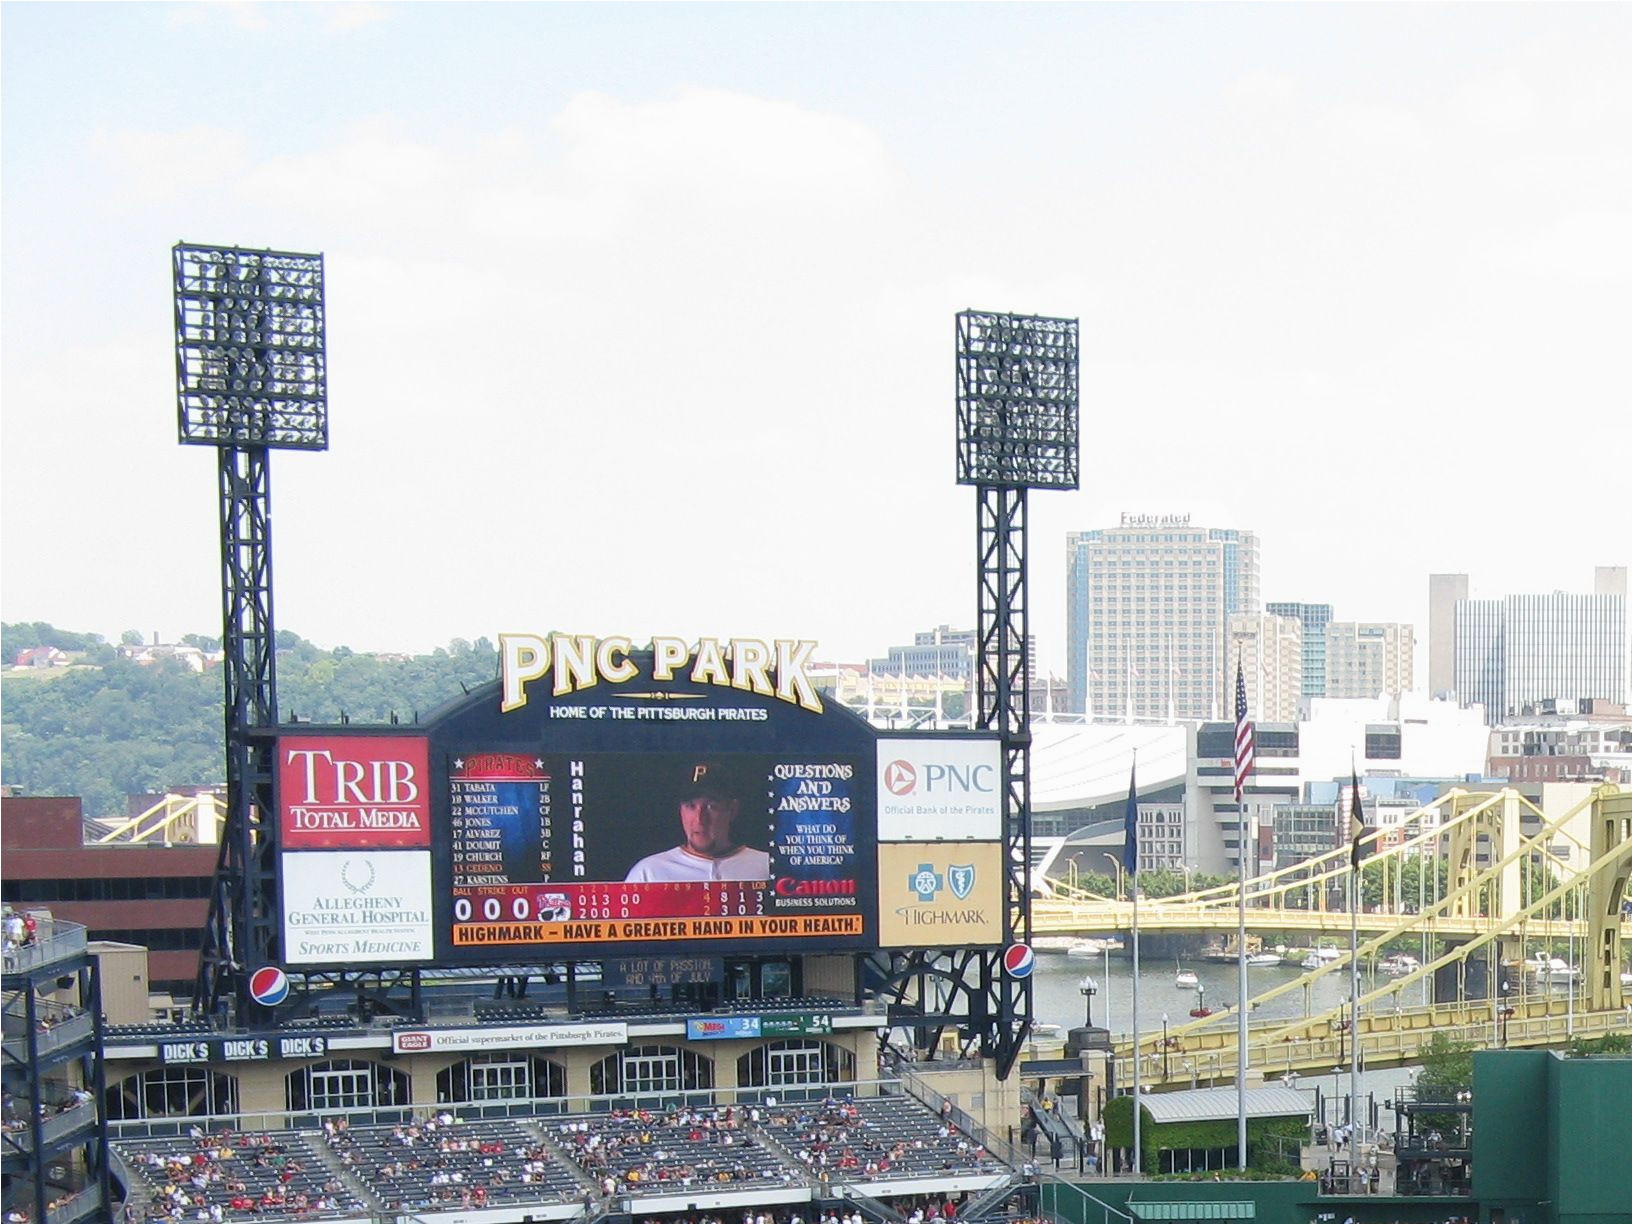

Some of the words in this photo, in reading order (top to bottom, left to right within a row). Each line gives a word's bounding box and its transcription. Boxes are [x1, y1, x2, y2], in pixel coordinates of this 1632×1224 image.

[1120, 512, 1191, 524] Federated
[499, 632, 640, 713] PNC
[651, 636, 824, 714] PARK
[549, 706, 588, 719] HOME
[589, 706, 606, 719] OF
[609, 706, 636, 719] THE
[637, 706, 715, 720] PITTSBURGH
[717, 707, 768, 721] PIRATES
[287, 750, 418, 804] TRIB
[774, 764, 853, 780] QUESTIONS
[922, 764, 994, 792] PNC
[464, 783, 496, 793] TABATA
[797, 780, 832, 796] AND
[464, 795, 499, 804] WALKER
[778, 796, 851, 813] ANSWERS
[465, 806, 519, 815] MCCUTCHEN
[884, 806, 914, 815] Official
[916, 806, 938, 815] Bank
[941, 806, 949, 815] of
[950, 806, 963, 815] the
[966, 805, 994, 815] Pirates
[290, 808, 357, 828] TOTAL
[359, 808, 421, 828] MEDIA
[465, 818, 492, 828] JONES
[570, 761, 585, 876] Hanrahan
[465, 829, 501, 838] ALVAREZ
[795, 824, 821, 834] WHAT
[823, 824, 837, 834] DO
[466, 841, 501, 850] DOUMIT
[785, 835, 805, 844] YOU
[806, 835, 833, 844] THINK
[834, 834, 847, 844] OF
[778, 845, 805, 855] WHEN
[808, 845, 825, 855] YOU
[827, 845, 854, 855] THINK
[465, 852, 503, 862] CHURCH
[790, 856, 803, 865] OF
[466, 874, 509, 885] KARSTENS
[453, 887, 472, 896] BALL
[477, 887, 506, 895] STRIKE
[511, 886, 528, 894] OUT
[776, 877, 858, 896] Canon
[313, 897, 403, 910] ALLEGHENY
[775, 898, 813, 907] BUSINESS
[814, 897, 856, 906] SOLUTIONS
[455, 899, 471, 920] 0
[484, 898, 500, 920] 0
[512, 898, 529, 919] 0
[288, 911, 360, 926] GENERAL
[361, 910, 430, 924] HOSPITAL
[903, 908, 986, 926] HIGHMARK
[458, 925, 543, 942] HIGHMARK
[563, 924, 602, 939] HAVE
[607, 924, 618, 938] A
[623, 921, 688, 938] GREATER
[692, 921, 733, 936] HAND
[739, 920, 753, 934] IN
[759, 920, 798, 934] YOUR
[803, 916, 858, 932] HEALTH.
[299, 941, 350, 955] SPORTS
[352, 940, 422, 955] MEDICINE
[742, 1019, 759, 1030] 34
[813, 1016, 829, 1027] 54
[401, 1035, 429, 1043] GIANT
[436, 1035, 470, 1046] Official
[471, 1034, 523, 1046] supermarket
[525, 1033, 534, 1041] of
[535, 1032, 548, 1041] the
[550, 1030, 592, 1042] Pittsburgh
[163, 1042, 209, 1059] DICK'S
[223, 1040, 269, 1057] DICK'S
[281, 1037, 325, 1054] DICK'S
